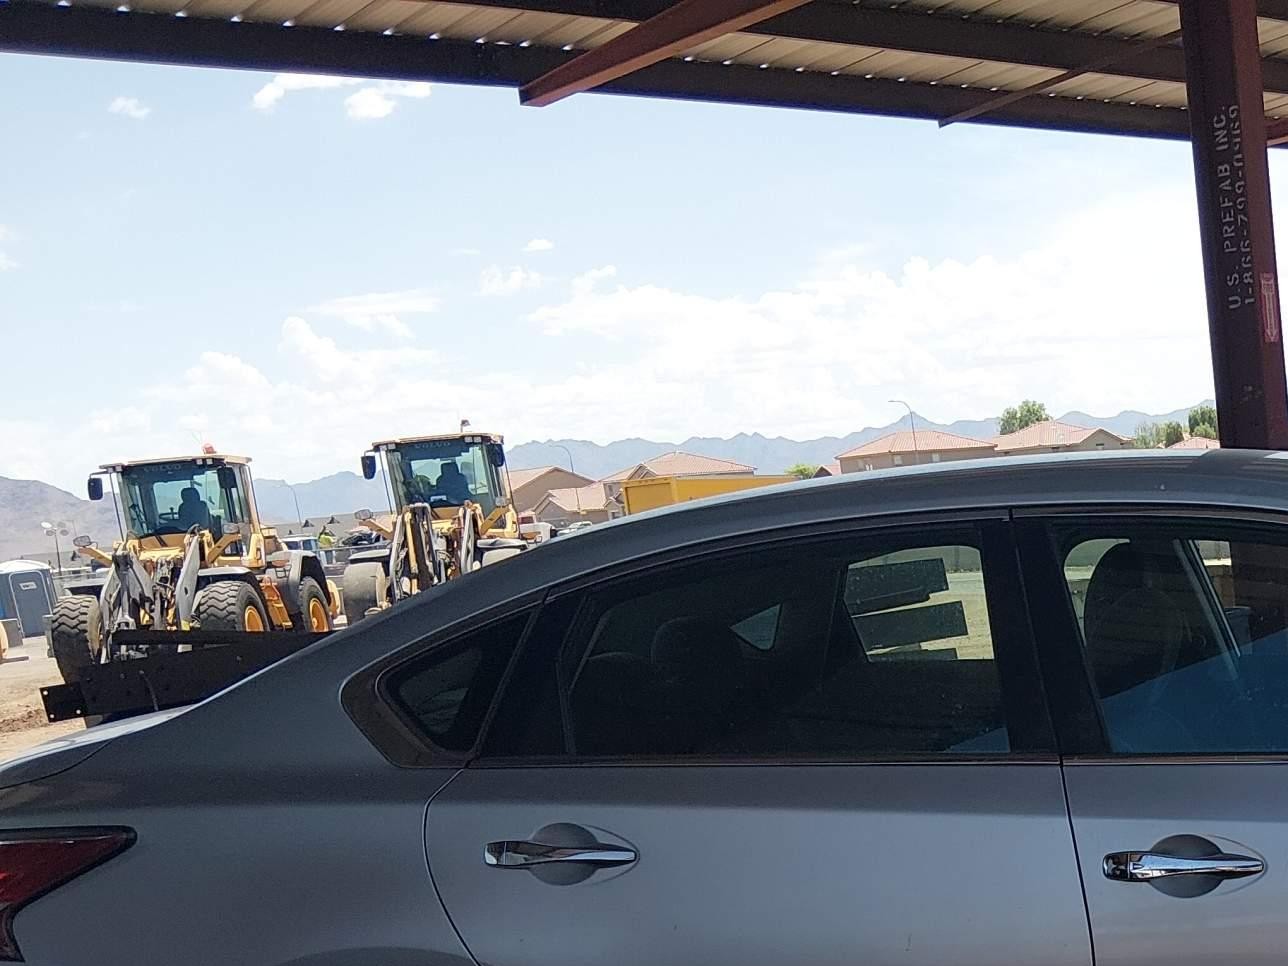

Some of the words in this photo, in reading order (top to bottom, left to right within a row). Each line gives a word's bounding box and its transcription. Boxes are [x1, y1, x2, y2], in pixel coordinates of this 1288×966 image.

[1213, 106, 1229, 151] INC.
[1217, 164, 1238, 253] PREFAB
[1227, 265, 1241, 309] U.S.
